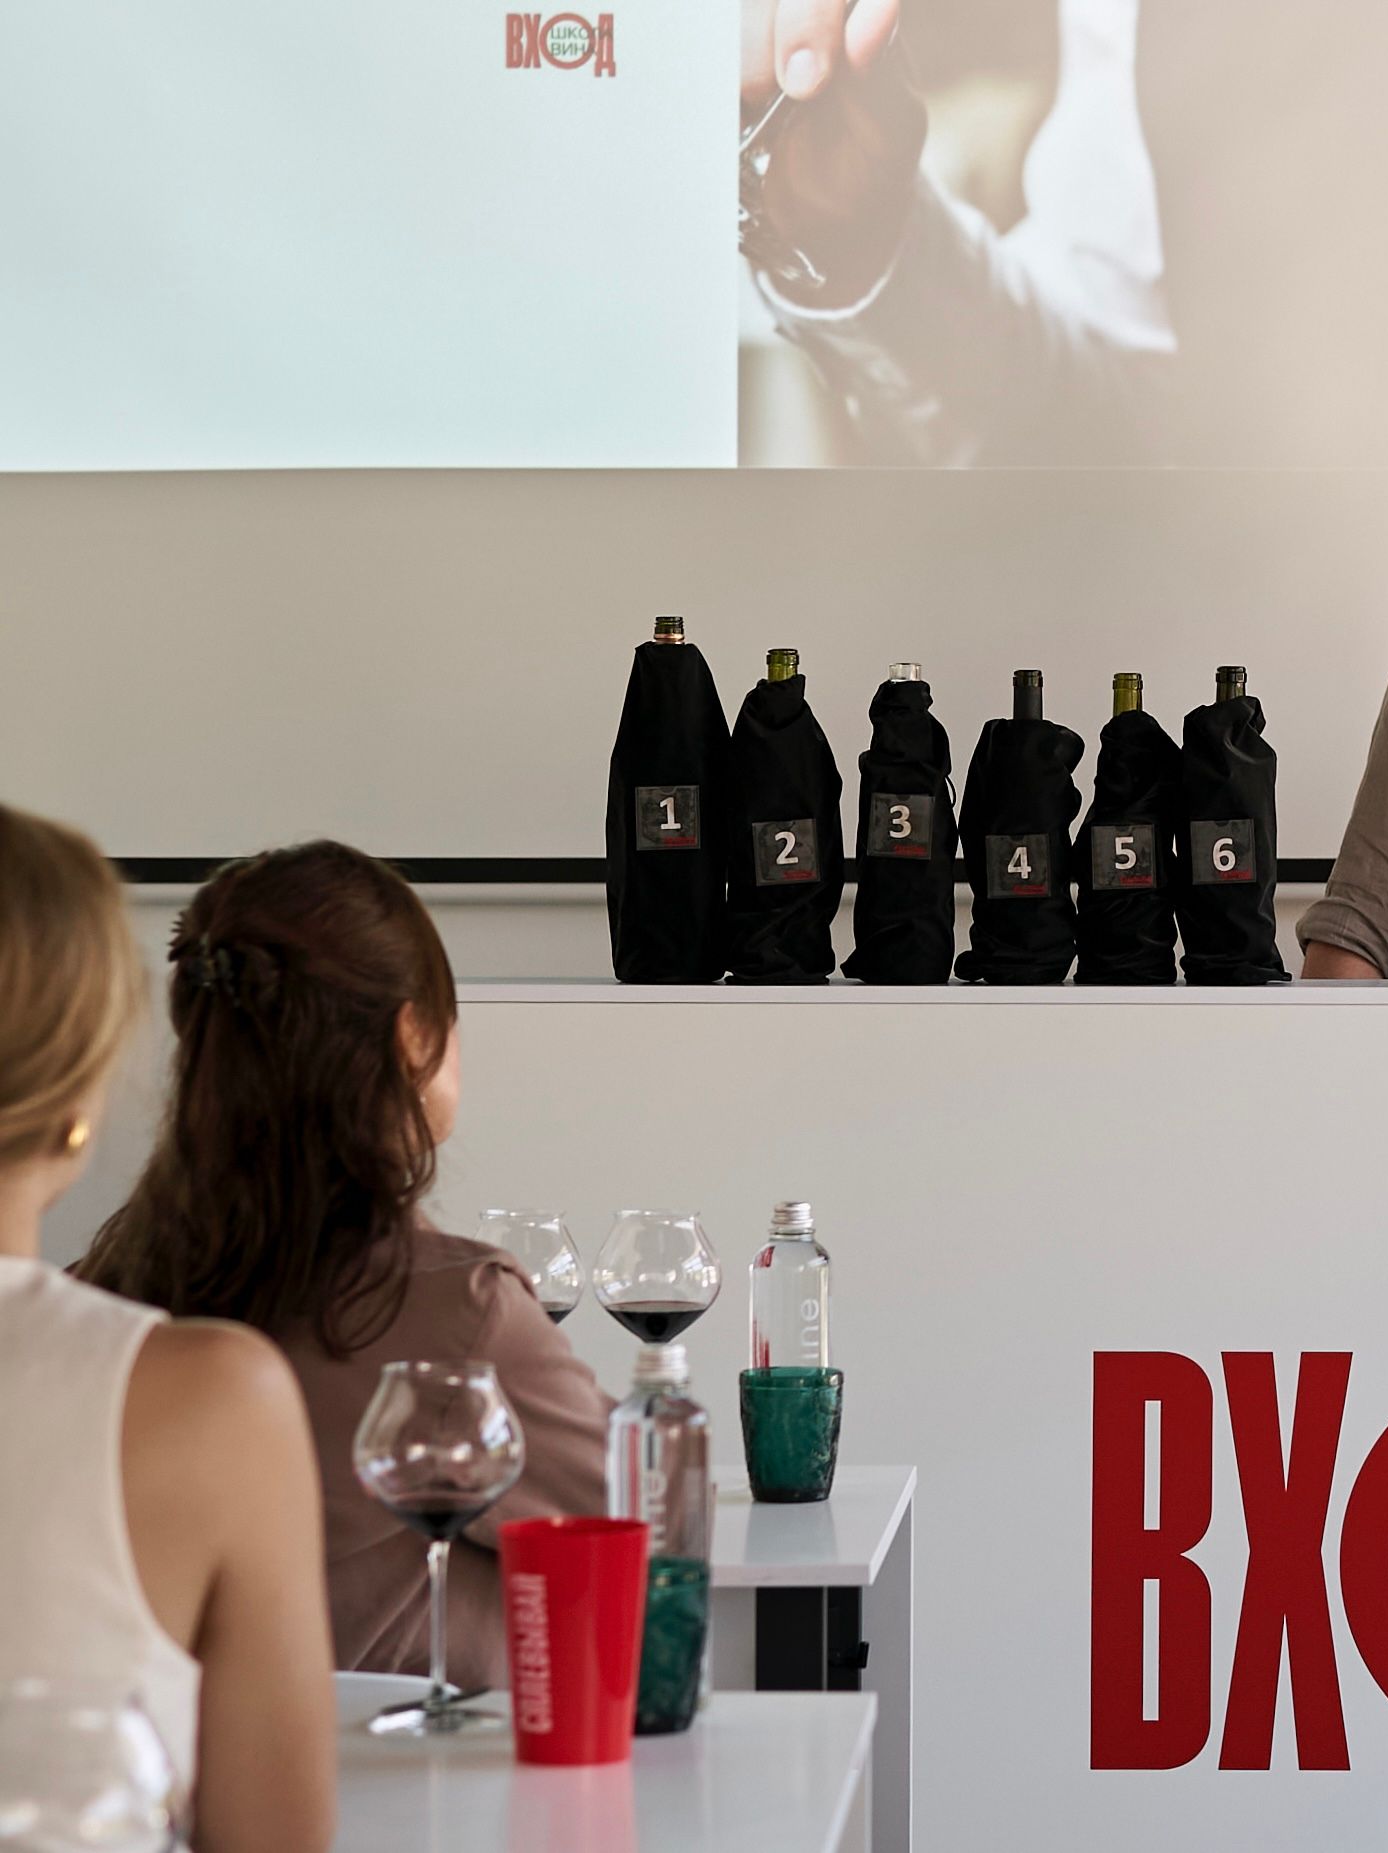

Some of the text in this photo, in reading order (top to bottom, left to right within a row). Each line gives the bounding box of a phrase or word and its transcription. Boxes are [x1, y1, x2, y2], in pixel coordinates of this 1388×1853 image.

[505, 12, 616, 78] ВХОД
[659, 796, 682, 831] 1
[888, 804, 912, 839] 3
[774, 831, 799, 865] 2
[1007, 846, 1032, 879] 4
[1114, 836, 1137, 870] 5
[1211, 837, 1236, 872] 6
[800, 1298, 820, 1360] ine
